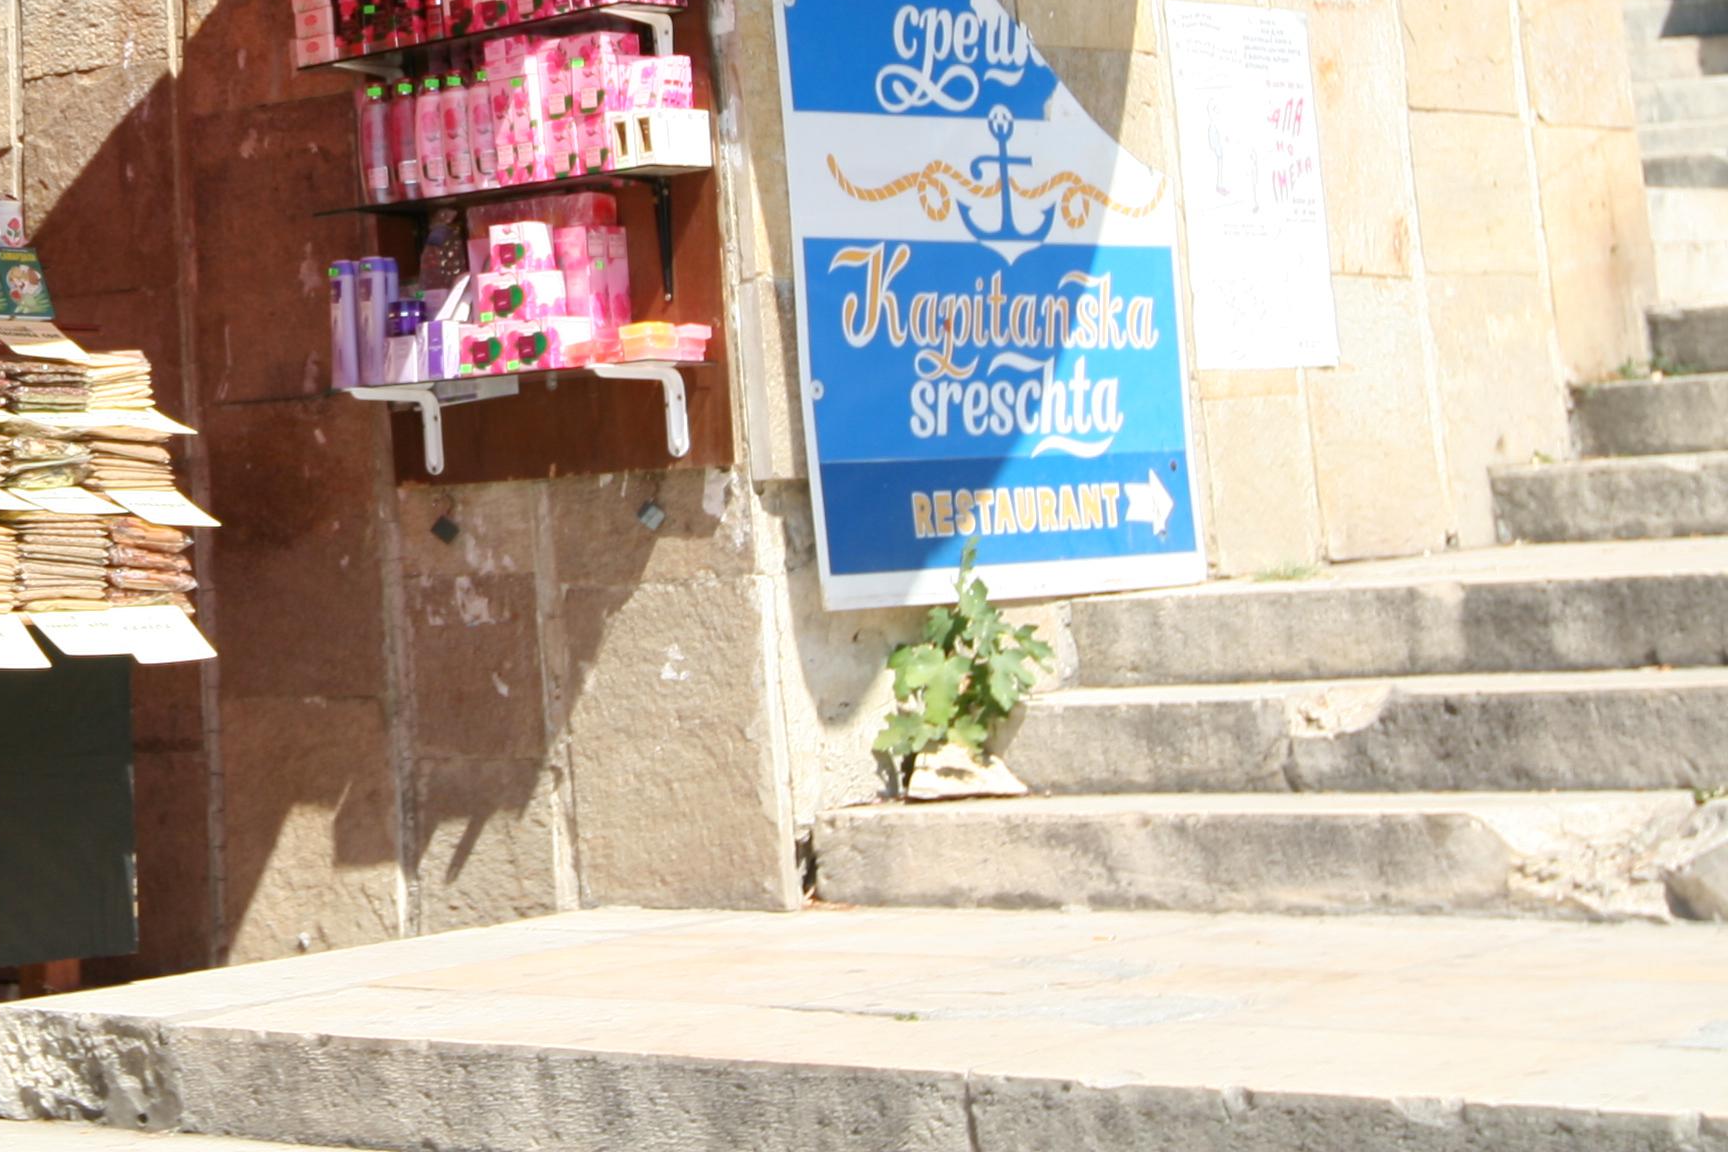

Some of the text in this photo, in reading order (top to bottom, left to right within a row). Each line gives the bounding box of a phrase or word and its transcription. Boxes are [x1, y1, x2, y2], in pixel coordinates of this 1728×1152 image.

[829, 241, 1159, 381] Kapitanska
[909, 351, 1124, 459] sreschta
[911, 482, 1121, 540] RESTAURANT
